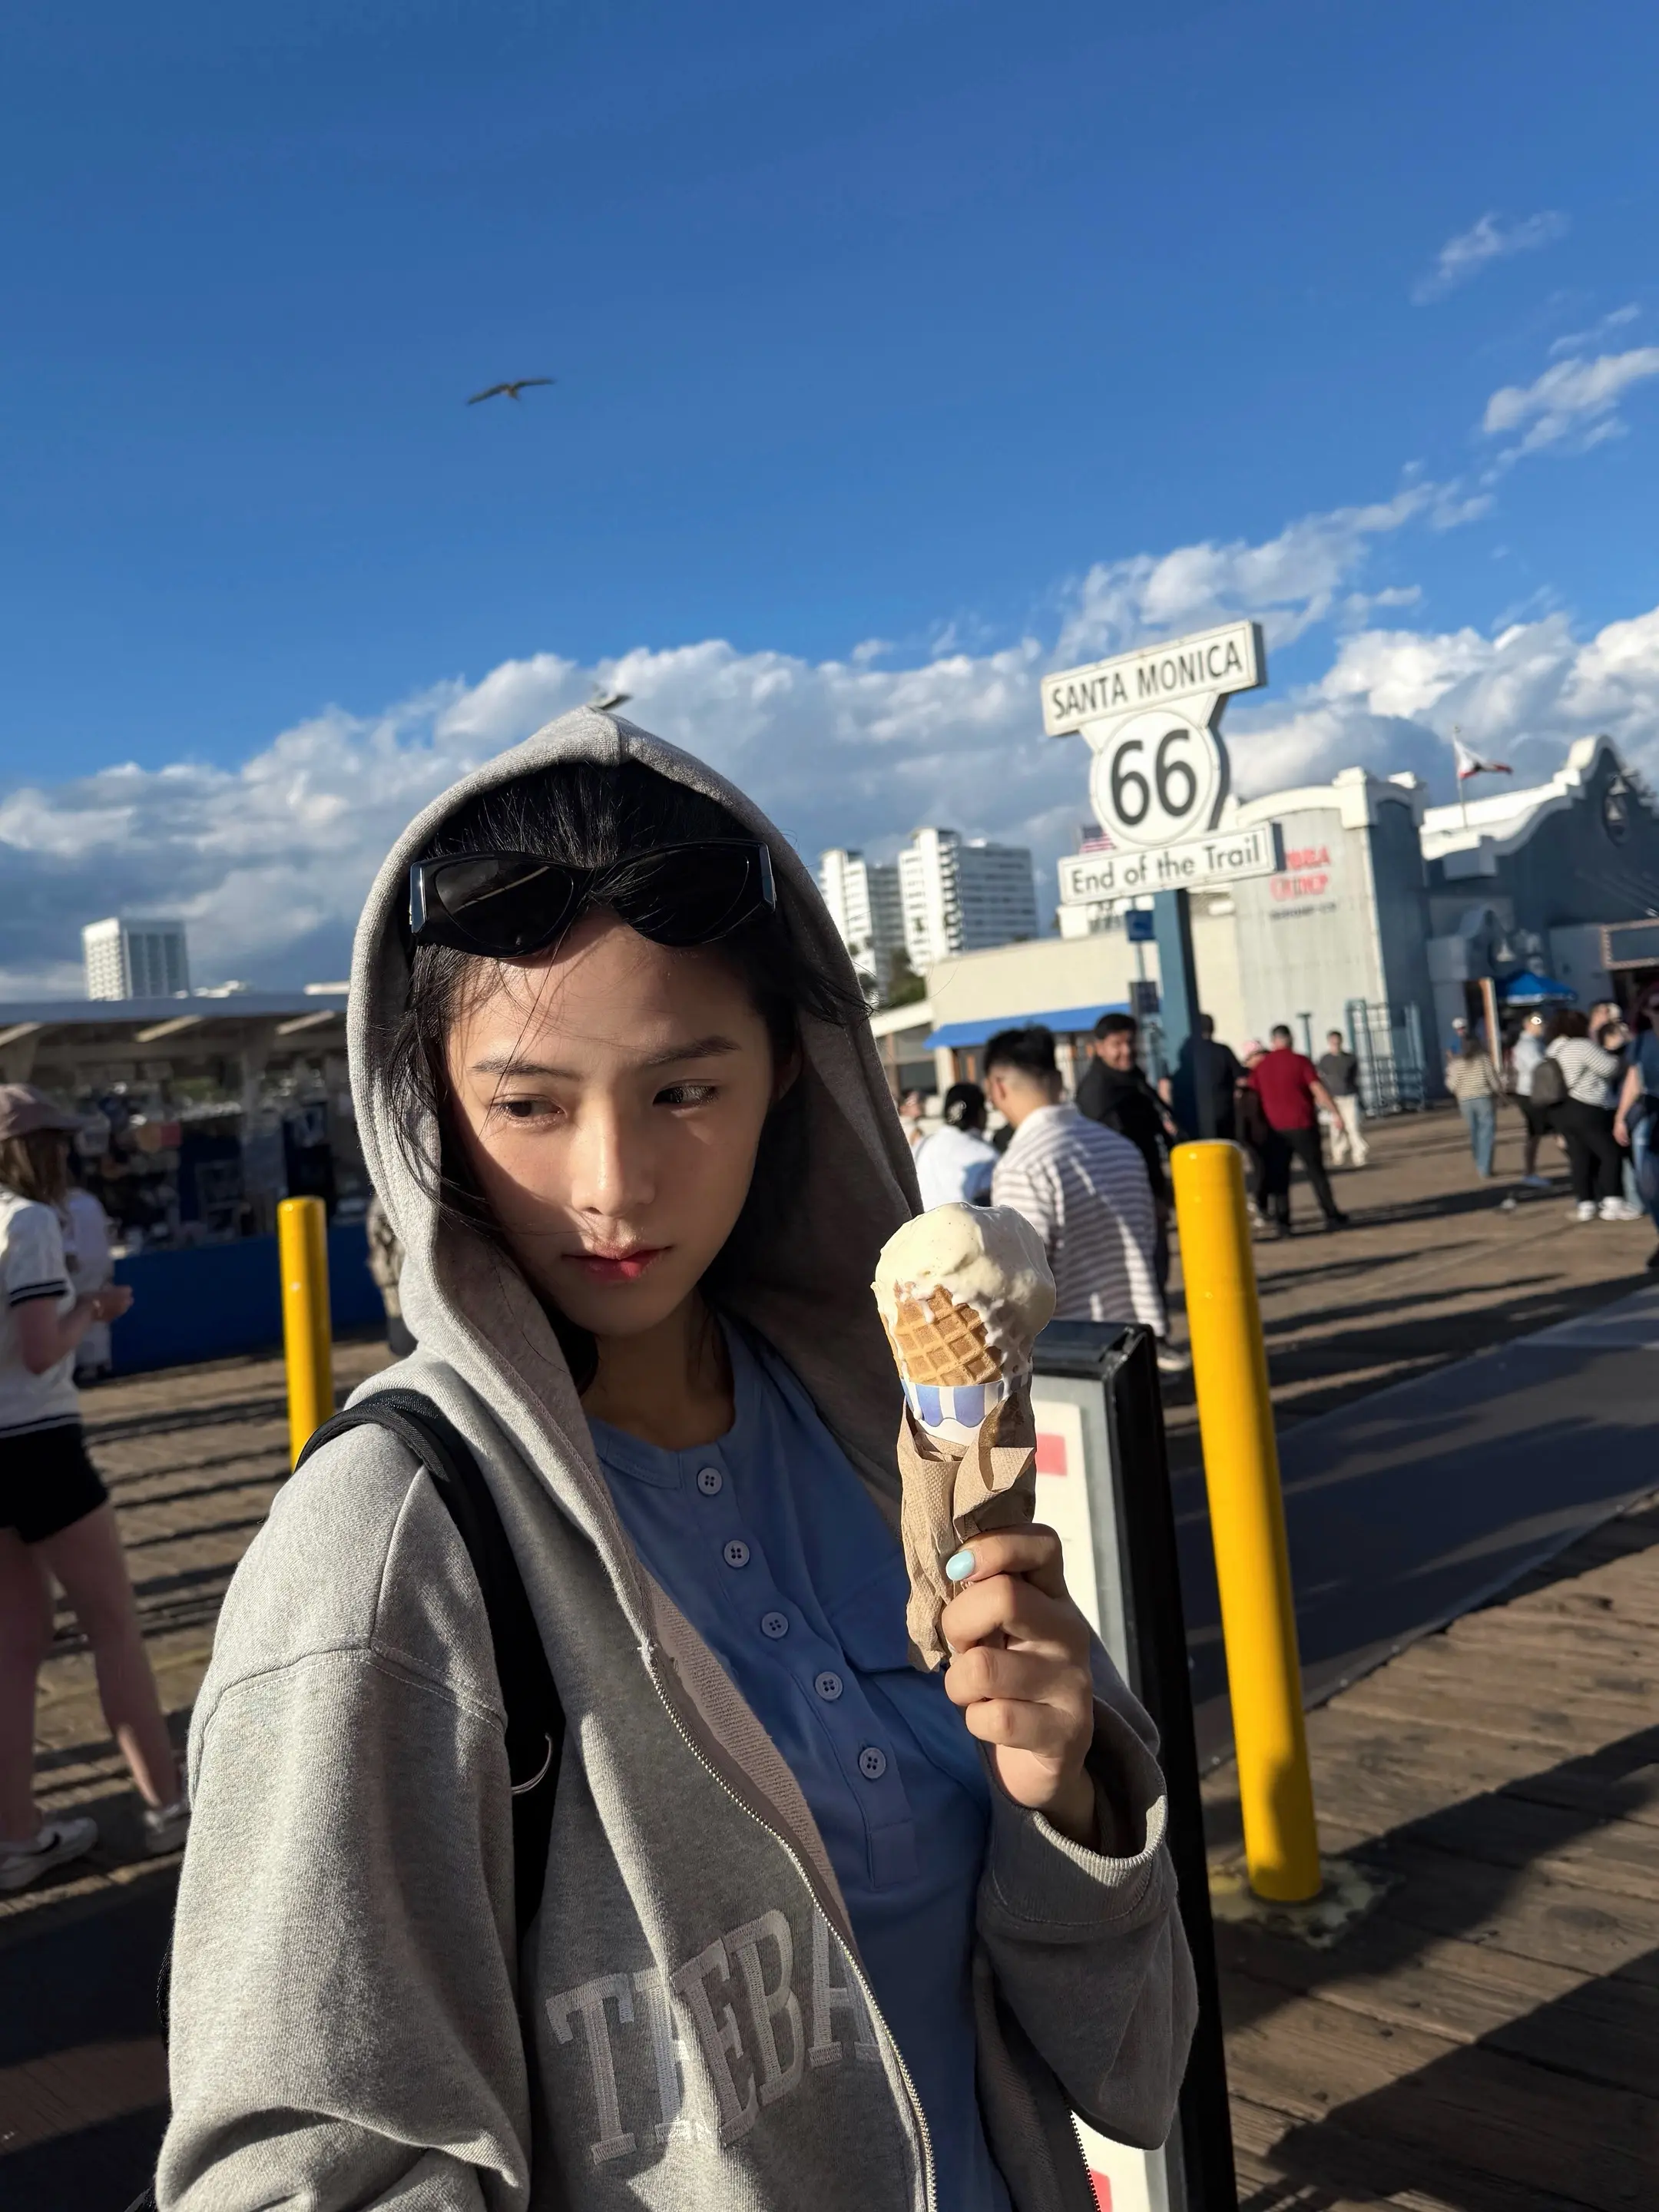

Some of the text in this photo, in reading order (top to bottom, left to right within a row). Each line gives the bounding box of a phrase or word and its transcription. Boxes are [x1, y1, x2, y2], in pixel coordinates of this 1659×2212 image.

[1051, 641, 1243, 719] SANTA MONICA
[1111, 729, 1197, 826] 66
[1071, 865, 1114, 894] End
[1124, 859, 1147, 883] of
[1157, 851, 1195, 880] the
[1204, 834, 1260, 873] Trail
